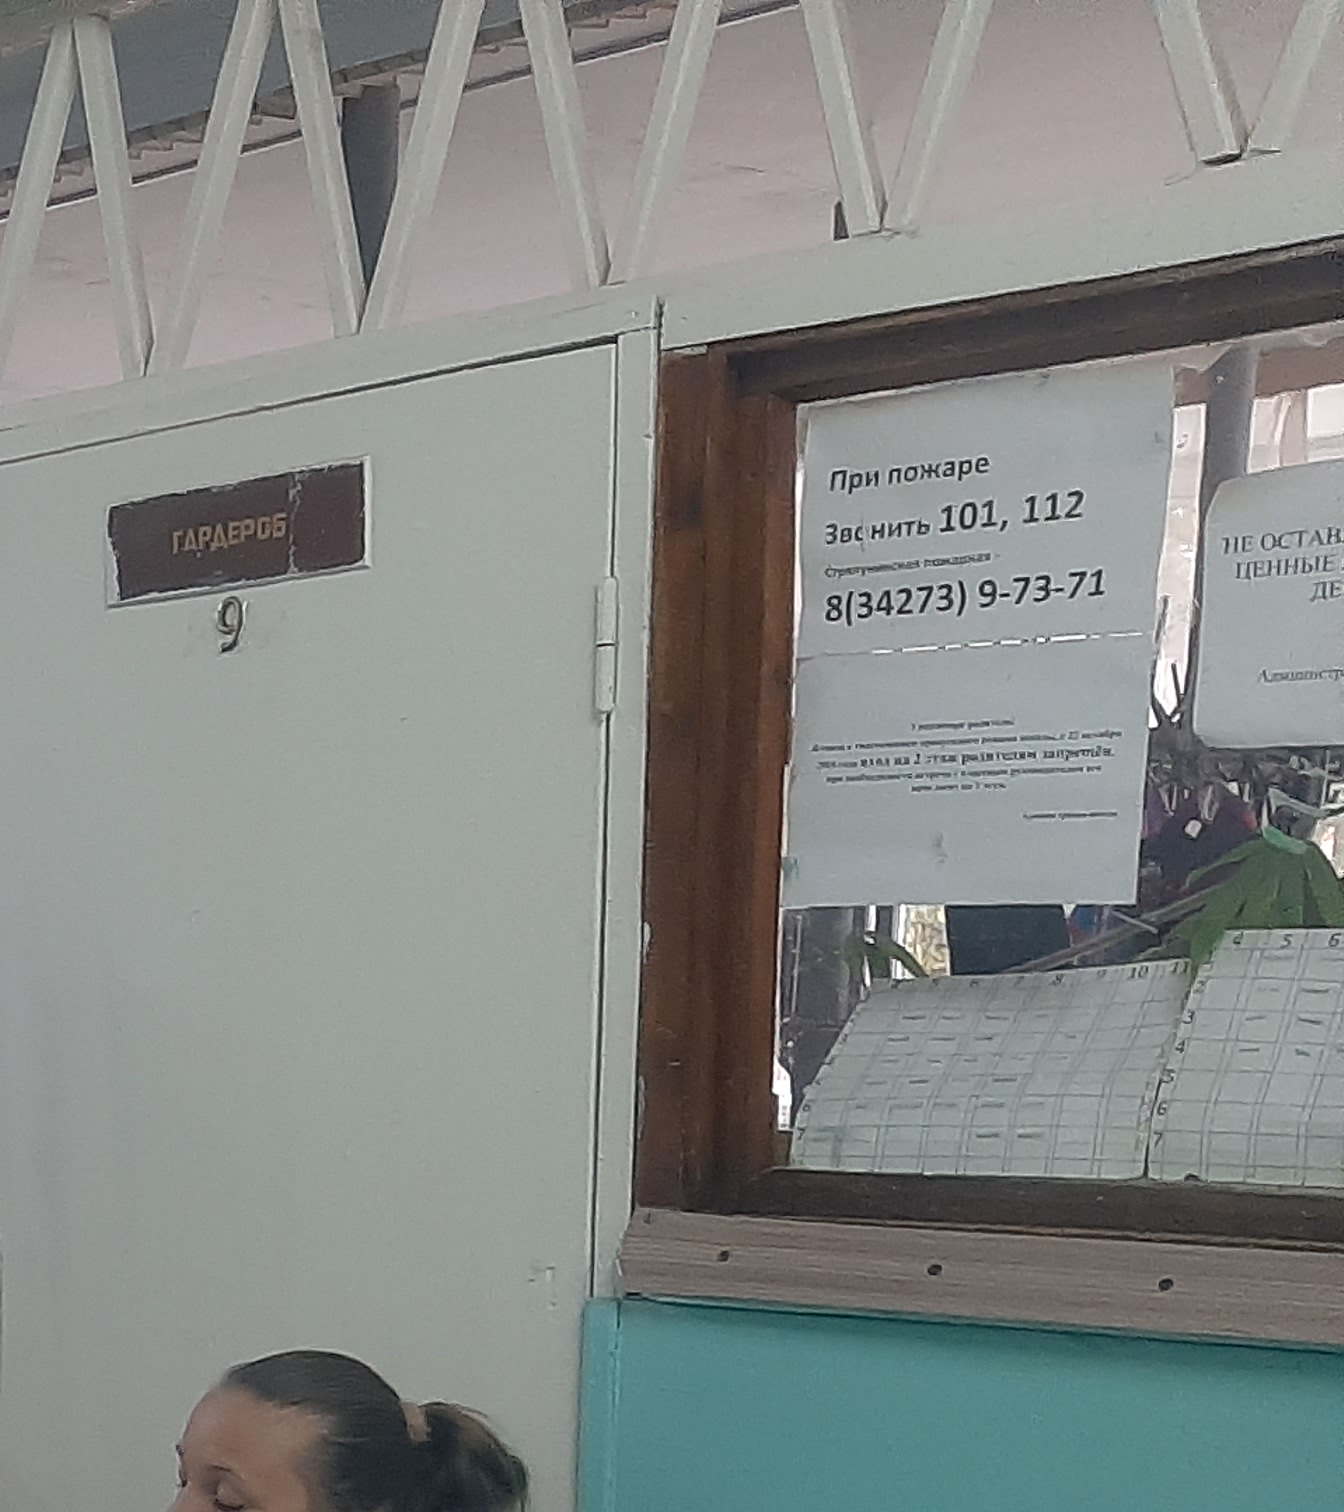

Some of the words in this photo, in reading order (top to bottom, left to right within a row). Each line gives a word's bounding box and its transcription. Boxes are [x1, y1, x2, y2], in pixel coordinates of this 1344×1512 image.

[829, 466, 880, 494] При
[887, 453, 990, 487] пожаре
[172, 512, 288, 555] ГАРДЕРОБ
[824, 517, 932, 547] Звонить
[938, 498, 1010, 535] 101,
[1021, 489, 1085, 525] 112
[1222, 536, 1254, 555] НЕ
[1260, 526, 1344, 551] ОСТАВ
[1235, 554, 1337, 580] ЦЕННЫЕ
[824, 580, 967, 627] 8(34273)
[978, 568, 1106, 609] 9-73-71
[216, 595, 244, 653] 9
